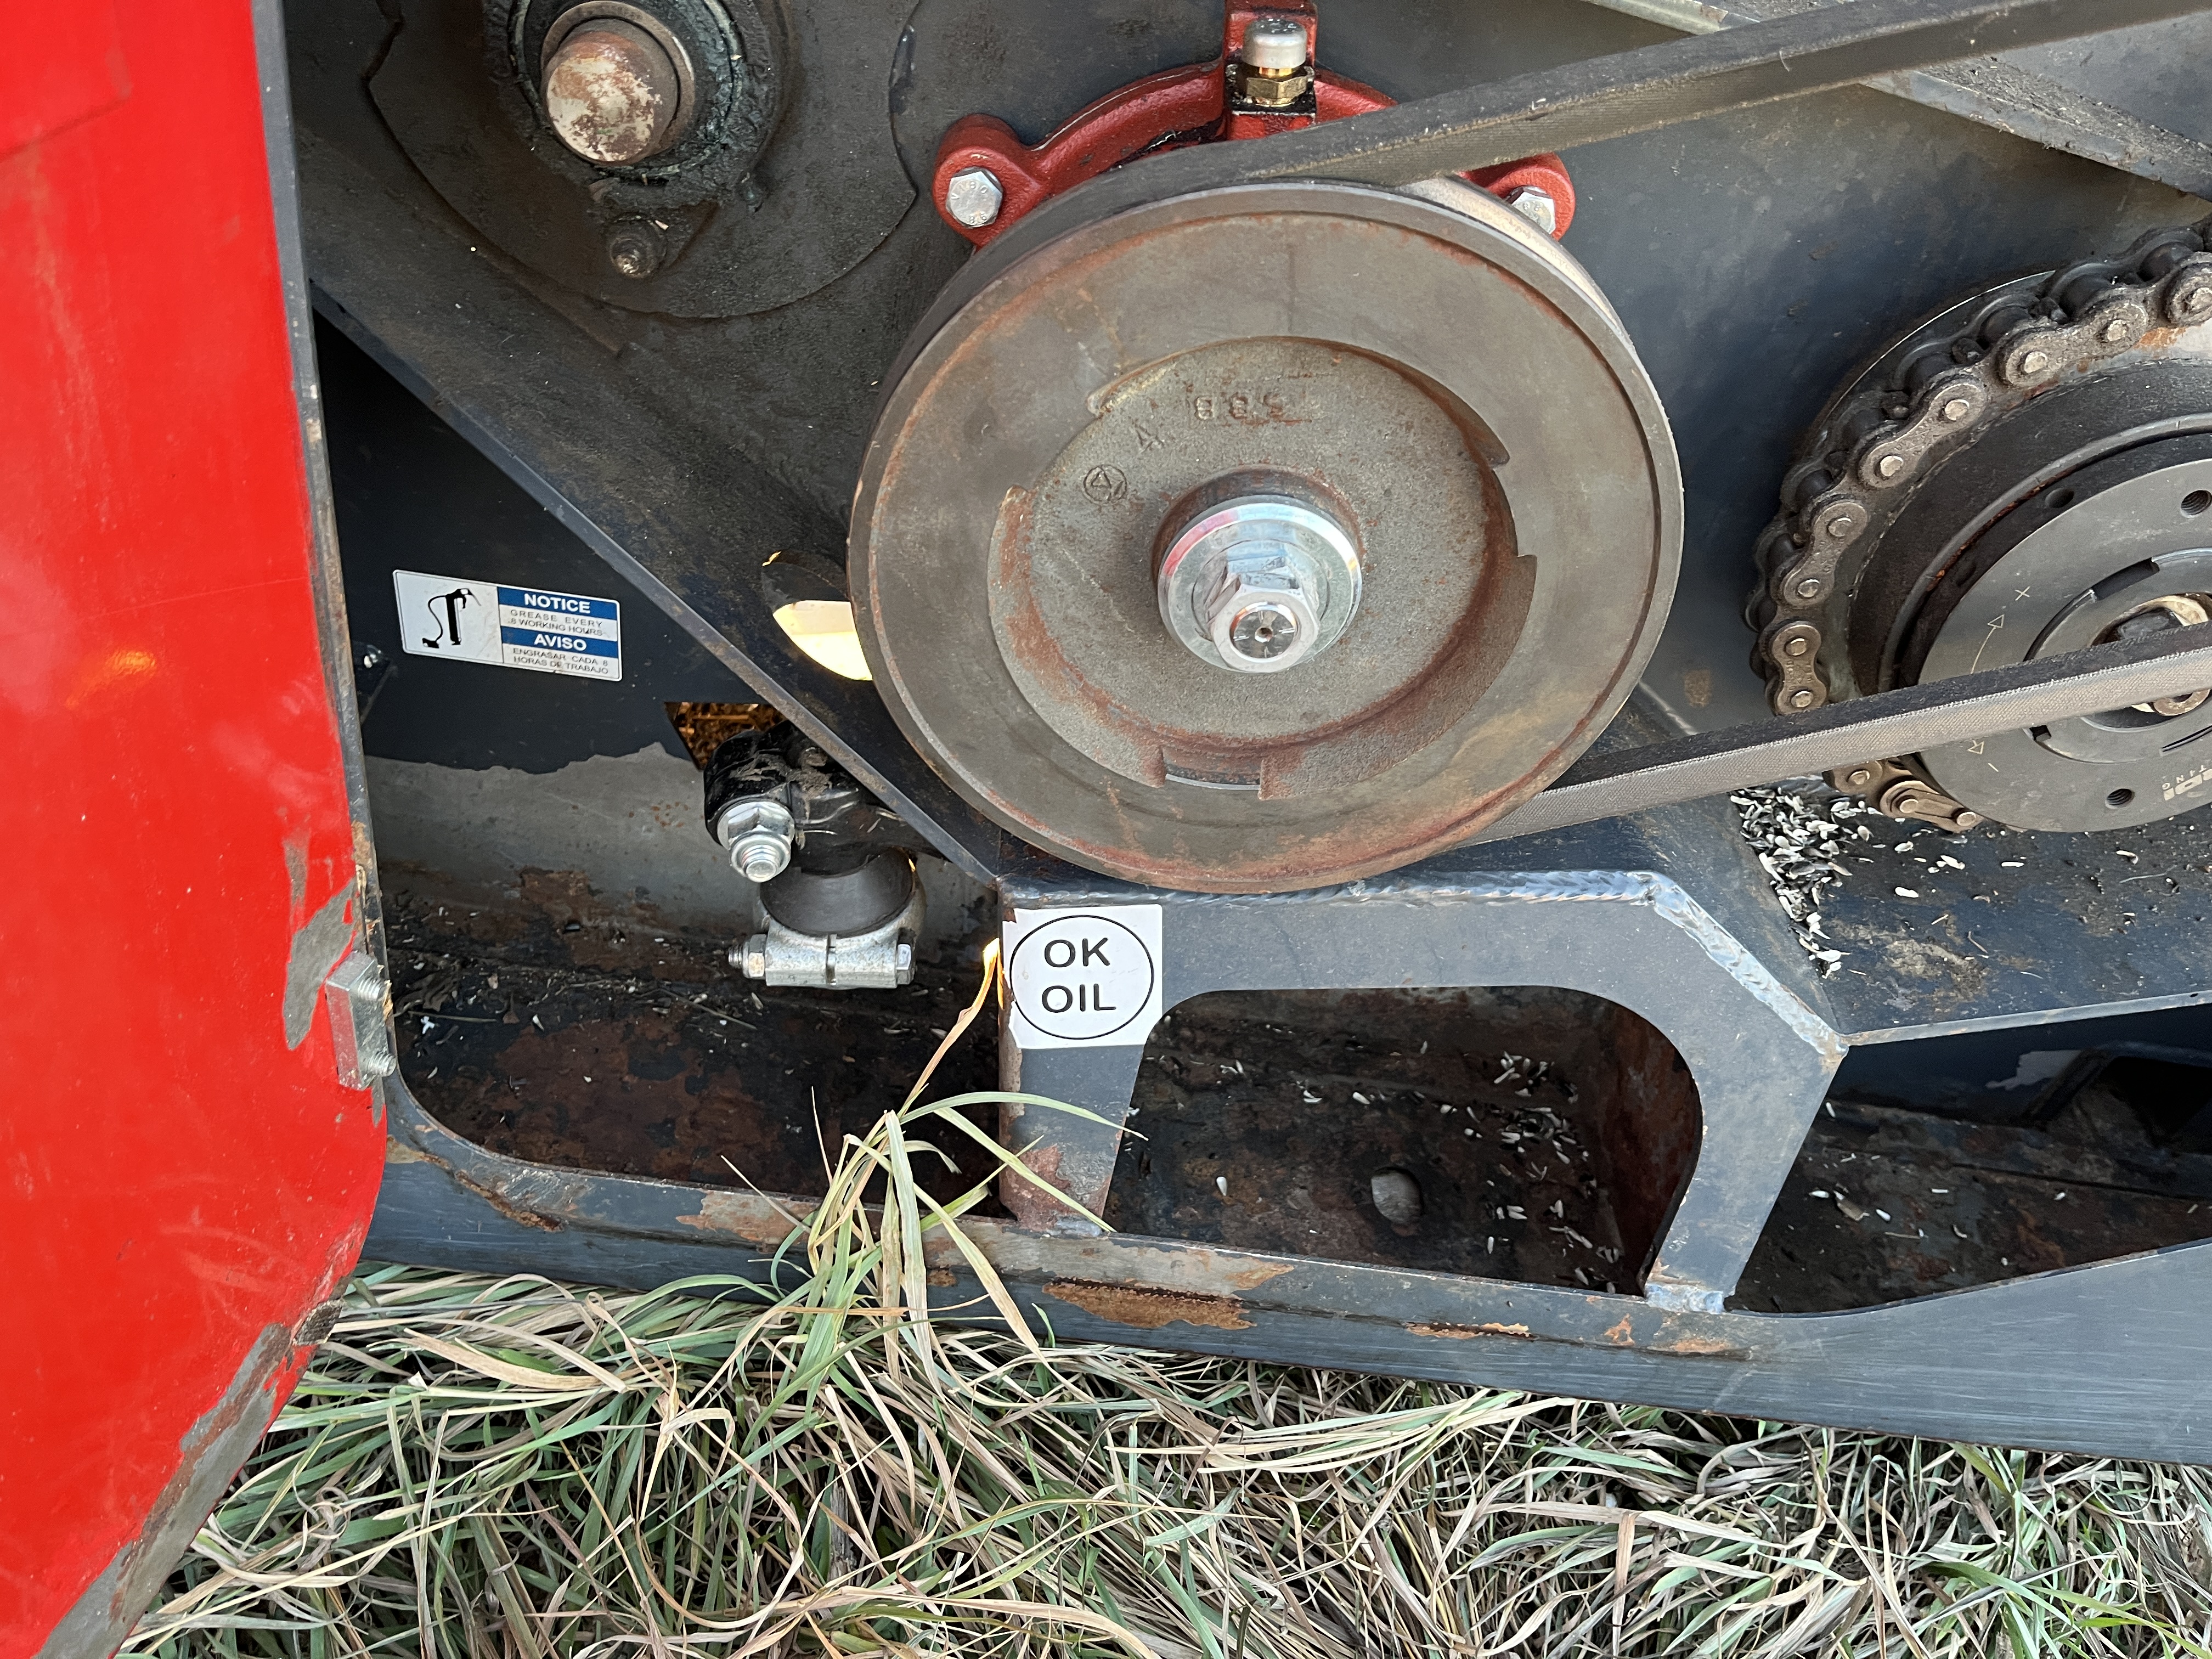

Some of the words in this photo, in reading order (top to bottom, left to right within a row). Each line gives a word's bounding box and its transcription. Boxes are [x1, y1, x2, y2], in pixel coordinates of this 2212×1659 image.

[524, 593, 591, 614] NOTICE
[510, 610, 557, 622] GREASE
[565, 617, 602, 628] EVERY
[518, 618, 566, 631] WORKING
[568, 625, 603, 636] HOURS
[534, 633, 587, 651] AVISO
[513, 648, 566, 659] ENGRASAR
[572, 656, 599, 665] CADA
[514, 656, 548, 666] HORAS
[566, 663, 608, 674] TRABAJO
[1043, 937, 1110, 968] OK
[1041, 983, 1116, 1013] OIL
